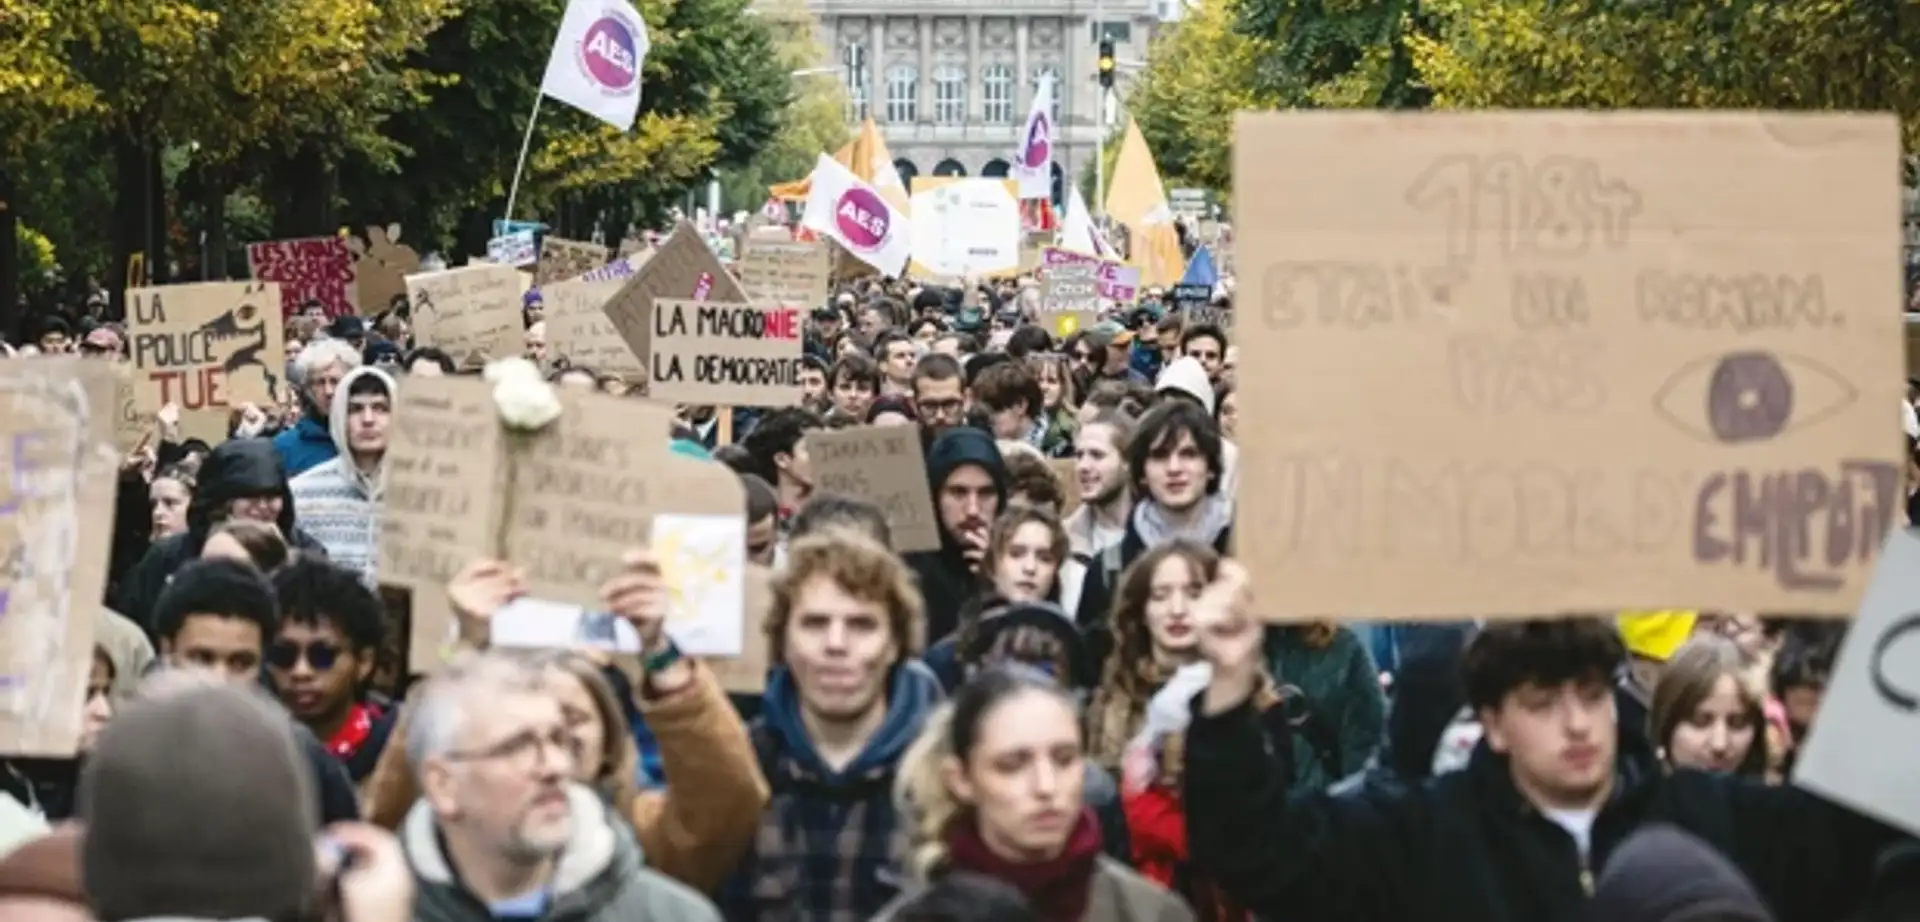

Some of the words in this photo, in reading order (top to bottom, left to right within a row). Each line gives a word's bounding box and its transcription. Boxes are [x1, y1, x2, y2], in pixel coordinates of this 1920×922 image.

[587, 30, 633, 74] AES
[838, 199, 885, 238] AES
[1403, 151, 1645, 268] 1984
[135, 293, 166, 325] LA
[655, 303, 688, 338] LA
[696, 305, 799, 339] MACRONIE
[135, 331, 218, 369] POLICE
[653, 352, 684, 382] LA
[695, 354, 804, 386] DEMOCRATIE
[149, 365, 229, 409] TUE
